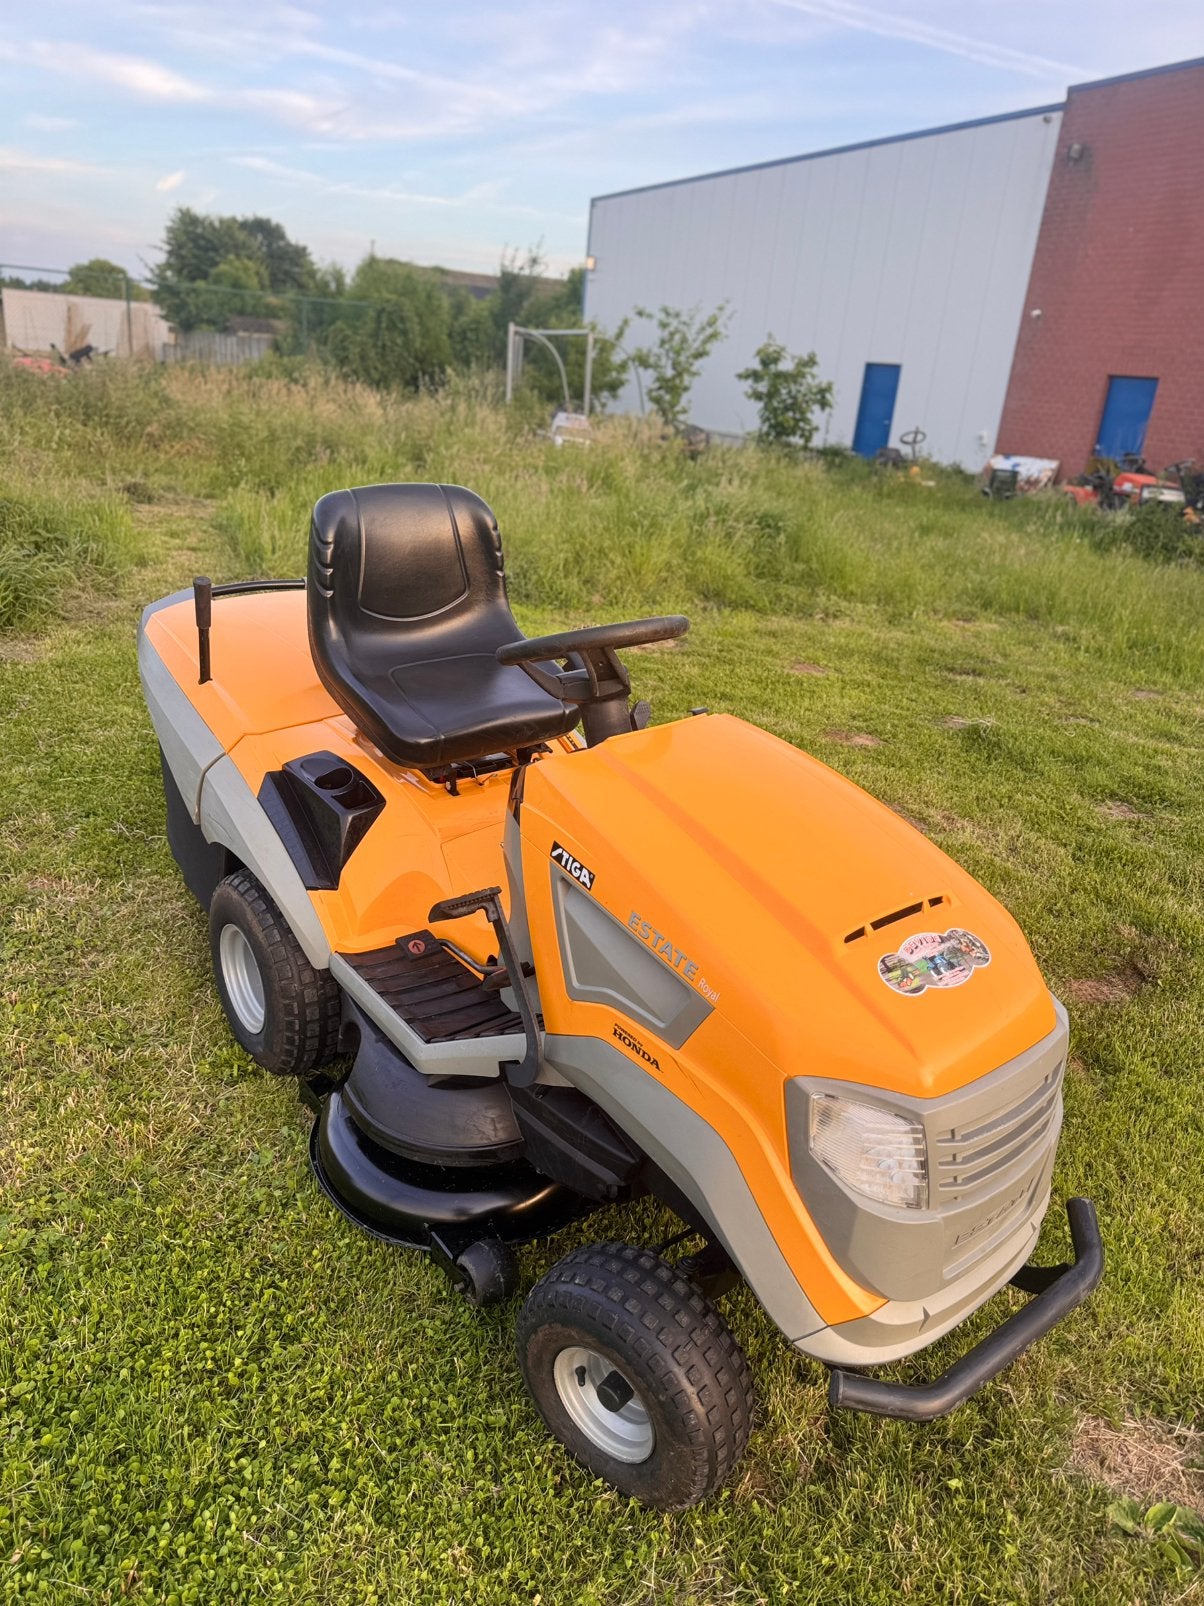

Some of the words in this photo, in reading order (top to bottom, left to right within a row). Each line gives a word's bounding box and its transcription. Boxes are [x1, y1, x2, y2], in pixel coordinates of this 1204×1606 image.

[551, 847, 592, 889] STIGA
[627, 911, 700, 982] ESTATE
[698, 977, 721, 1003] Royal
[612, 1027, 661, 1072] HONDA
